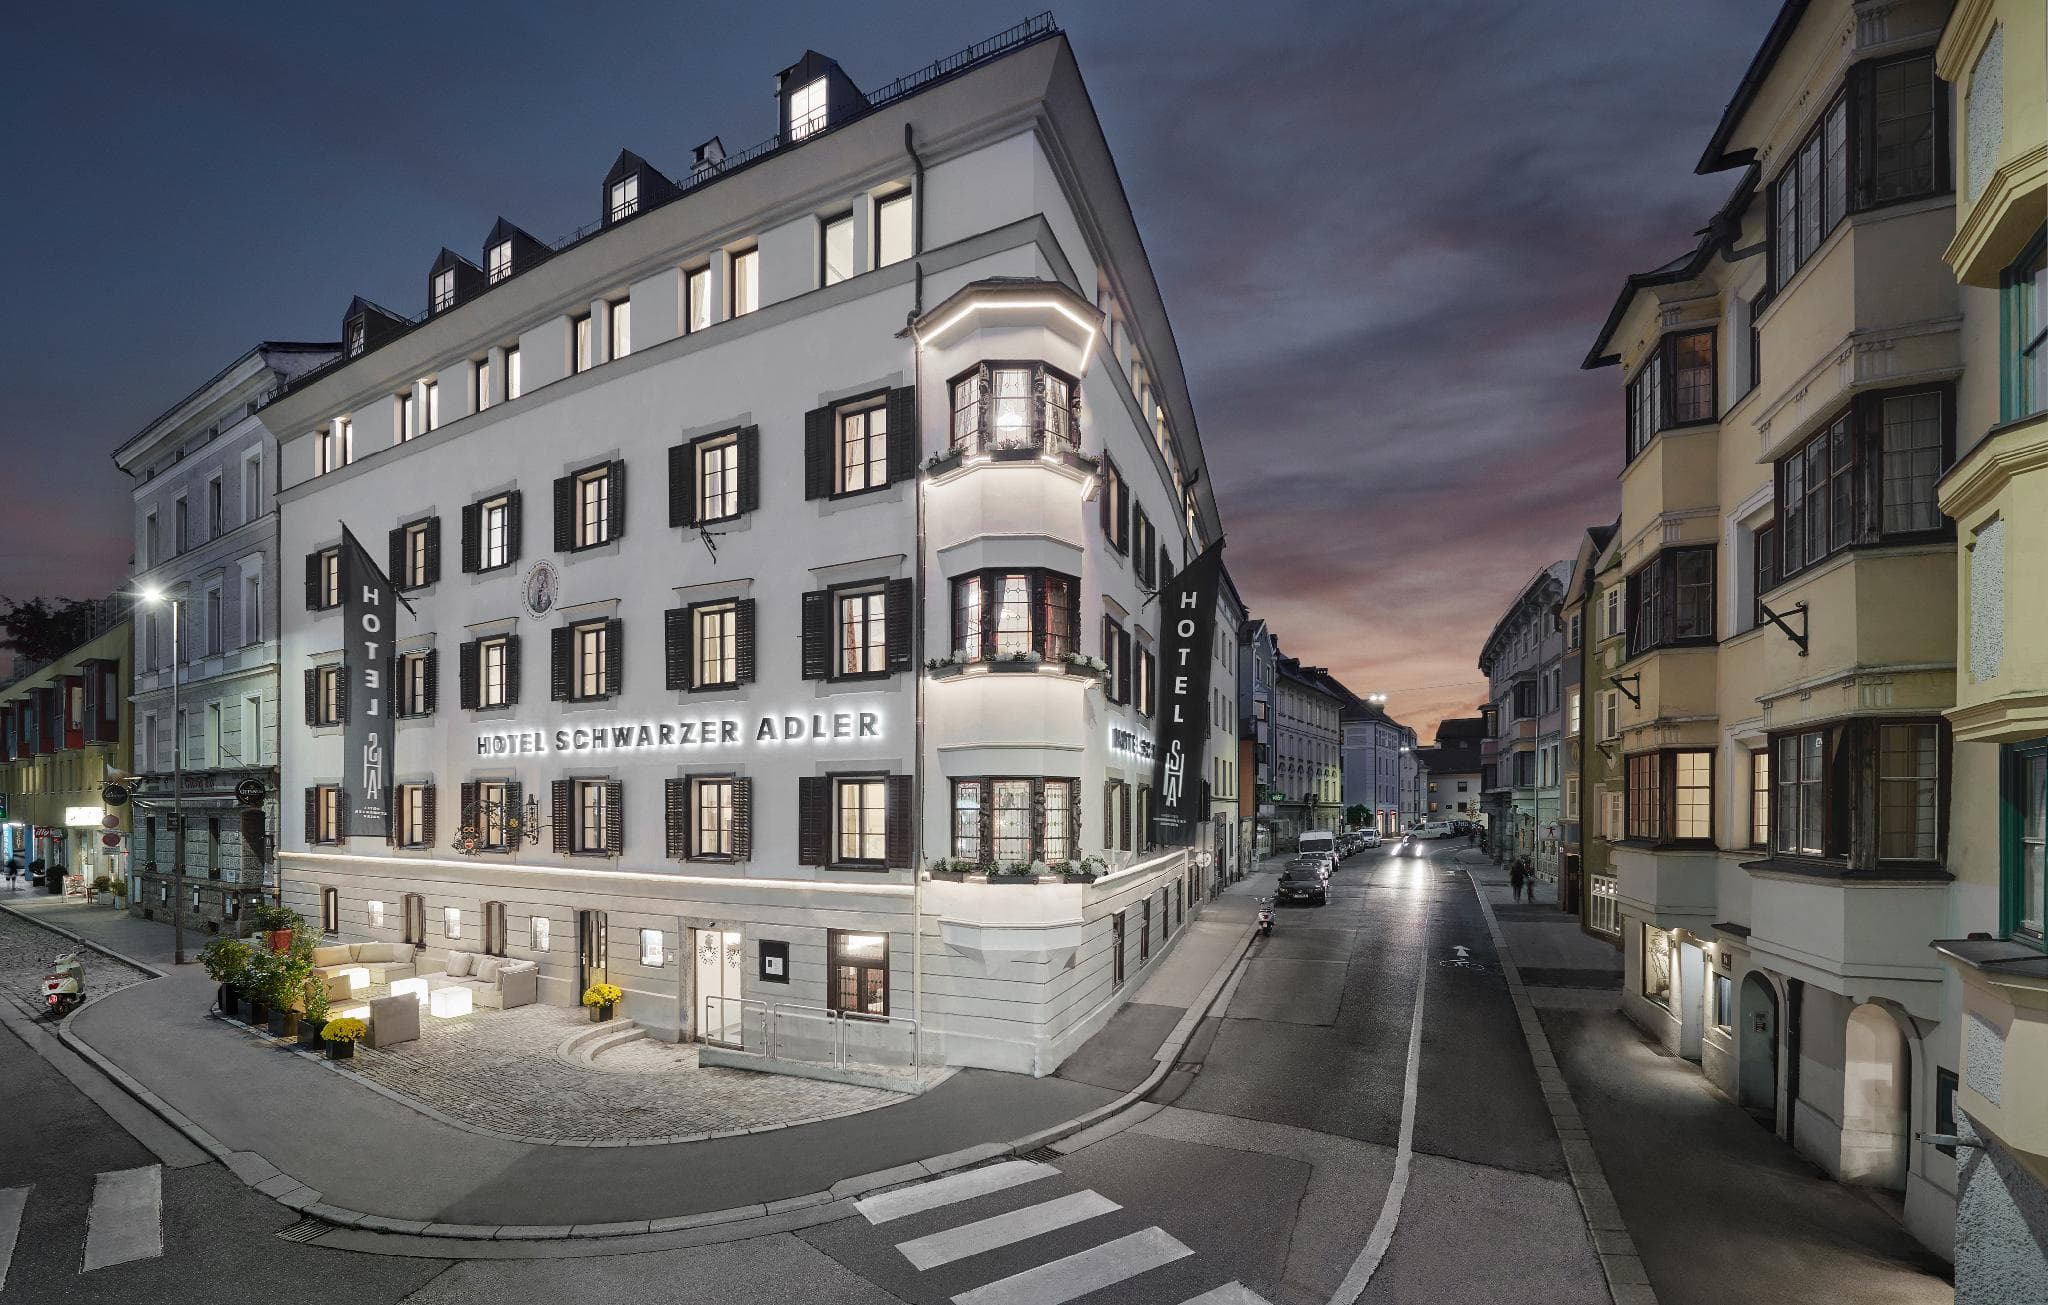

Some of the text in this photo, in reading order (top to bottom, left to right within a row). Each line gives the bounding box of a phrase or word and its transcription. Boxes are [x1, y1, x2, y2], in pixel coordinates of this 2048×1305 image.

[1174, 592, 1197, 723] HOTEL
[477, 712, 880, 755] HOTEL SCHWARZER ADLER
